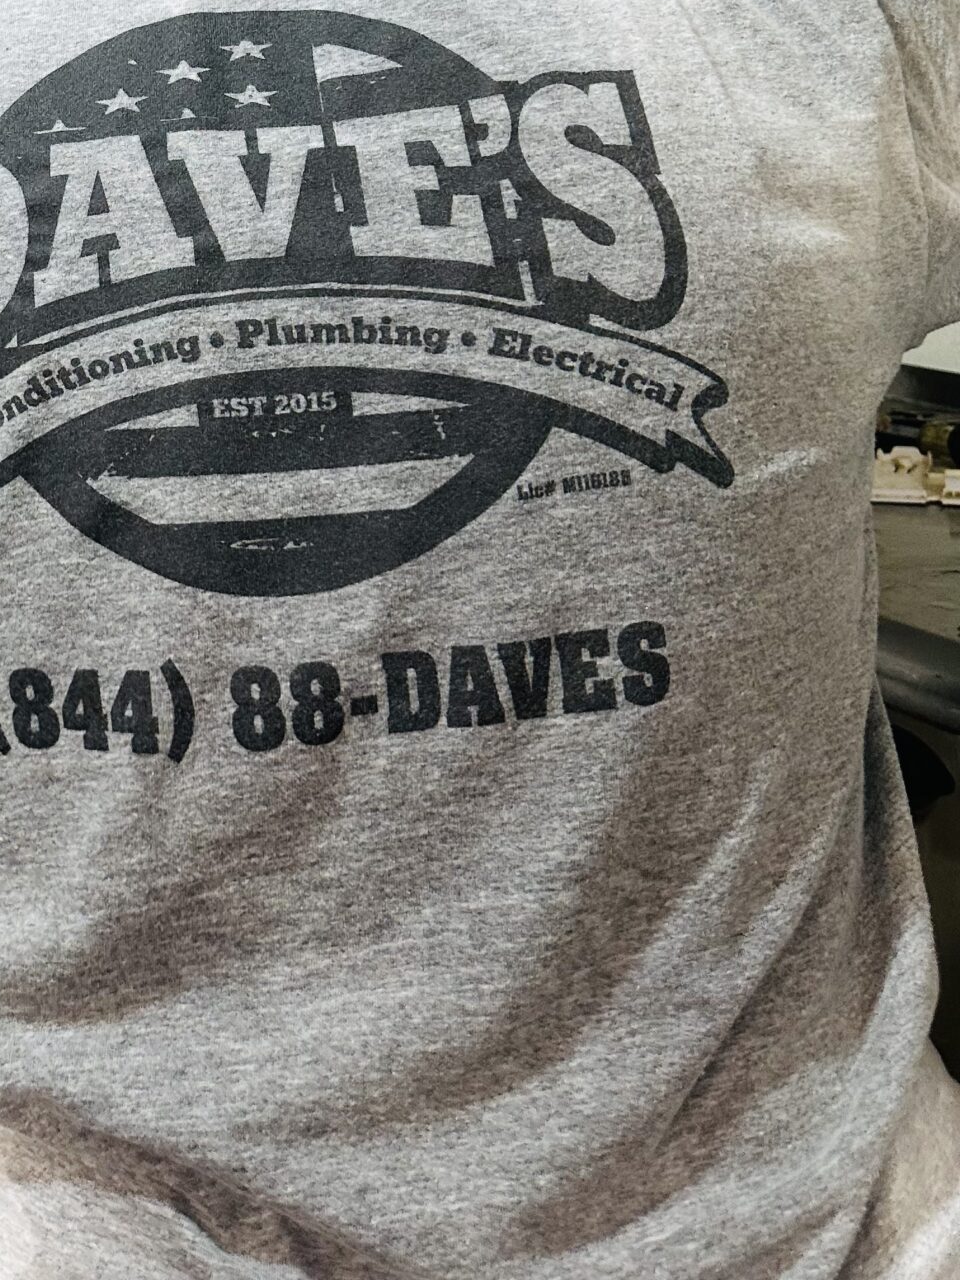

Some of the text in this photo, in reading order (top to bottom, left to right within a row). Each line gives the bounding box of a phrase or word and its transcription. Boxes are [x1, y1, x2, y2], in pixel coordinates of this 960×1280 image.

[212, 391, 337, 418] EST 2015
[235, 316, 450, 355] Plumbing
[488, 326, 685, 412] Electrical
[230, 620, 671, 751] 88-DAVES
